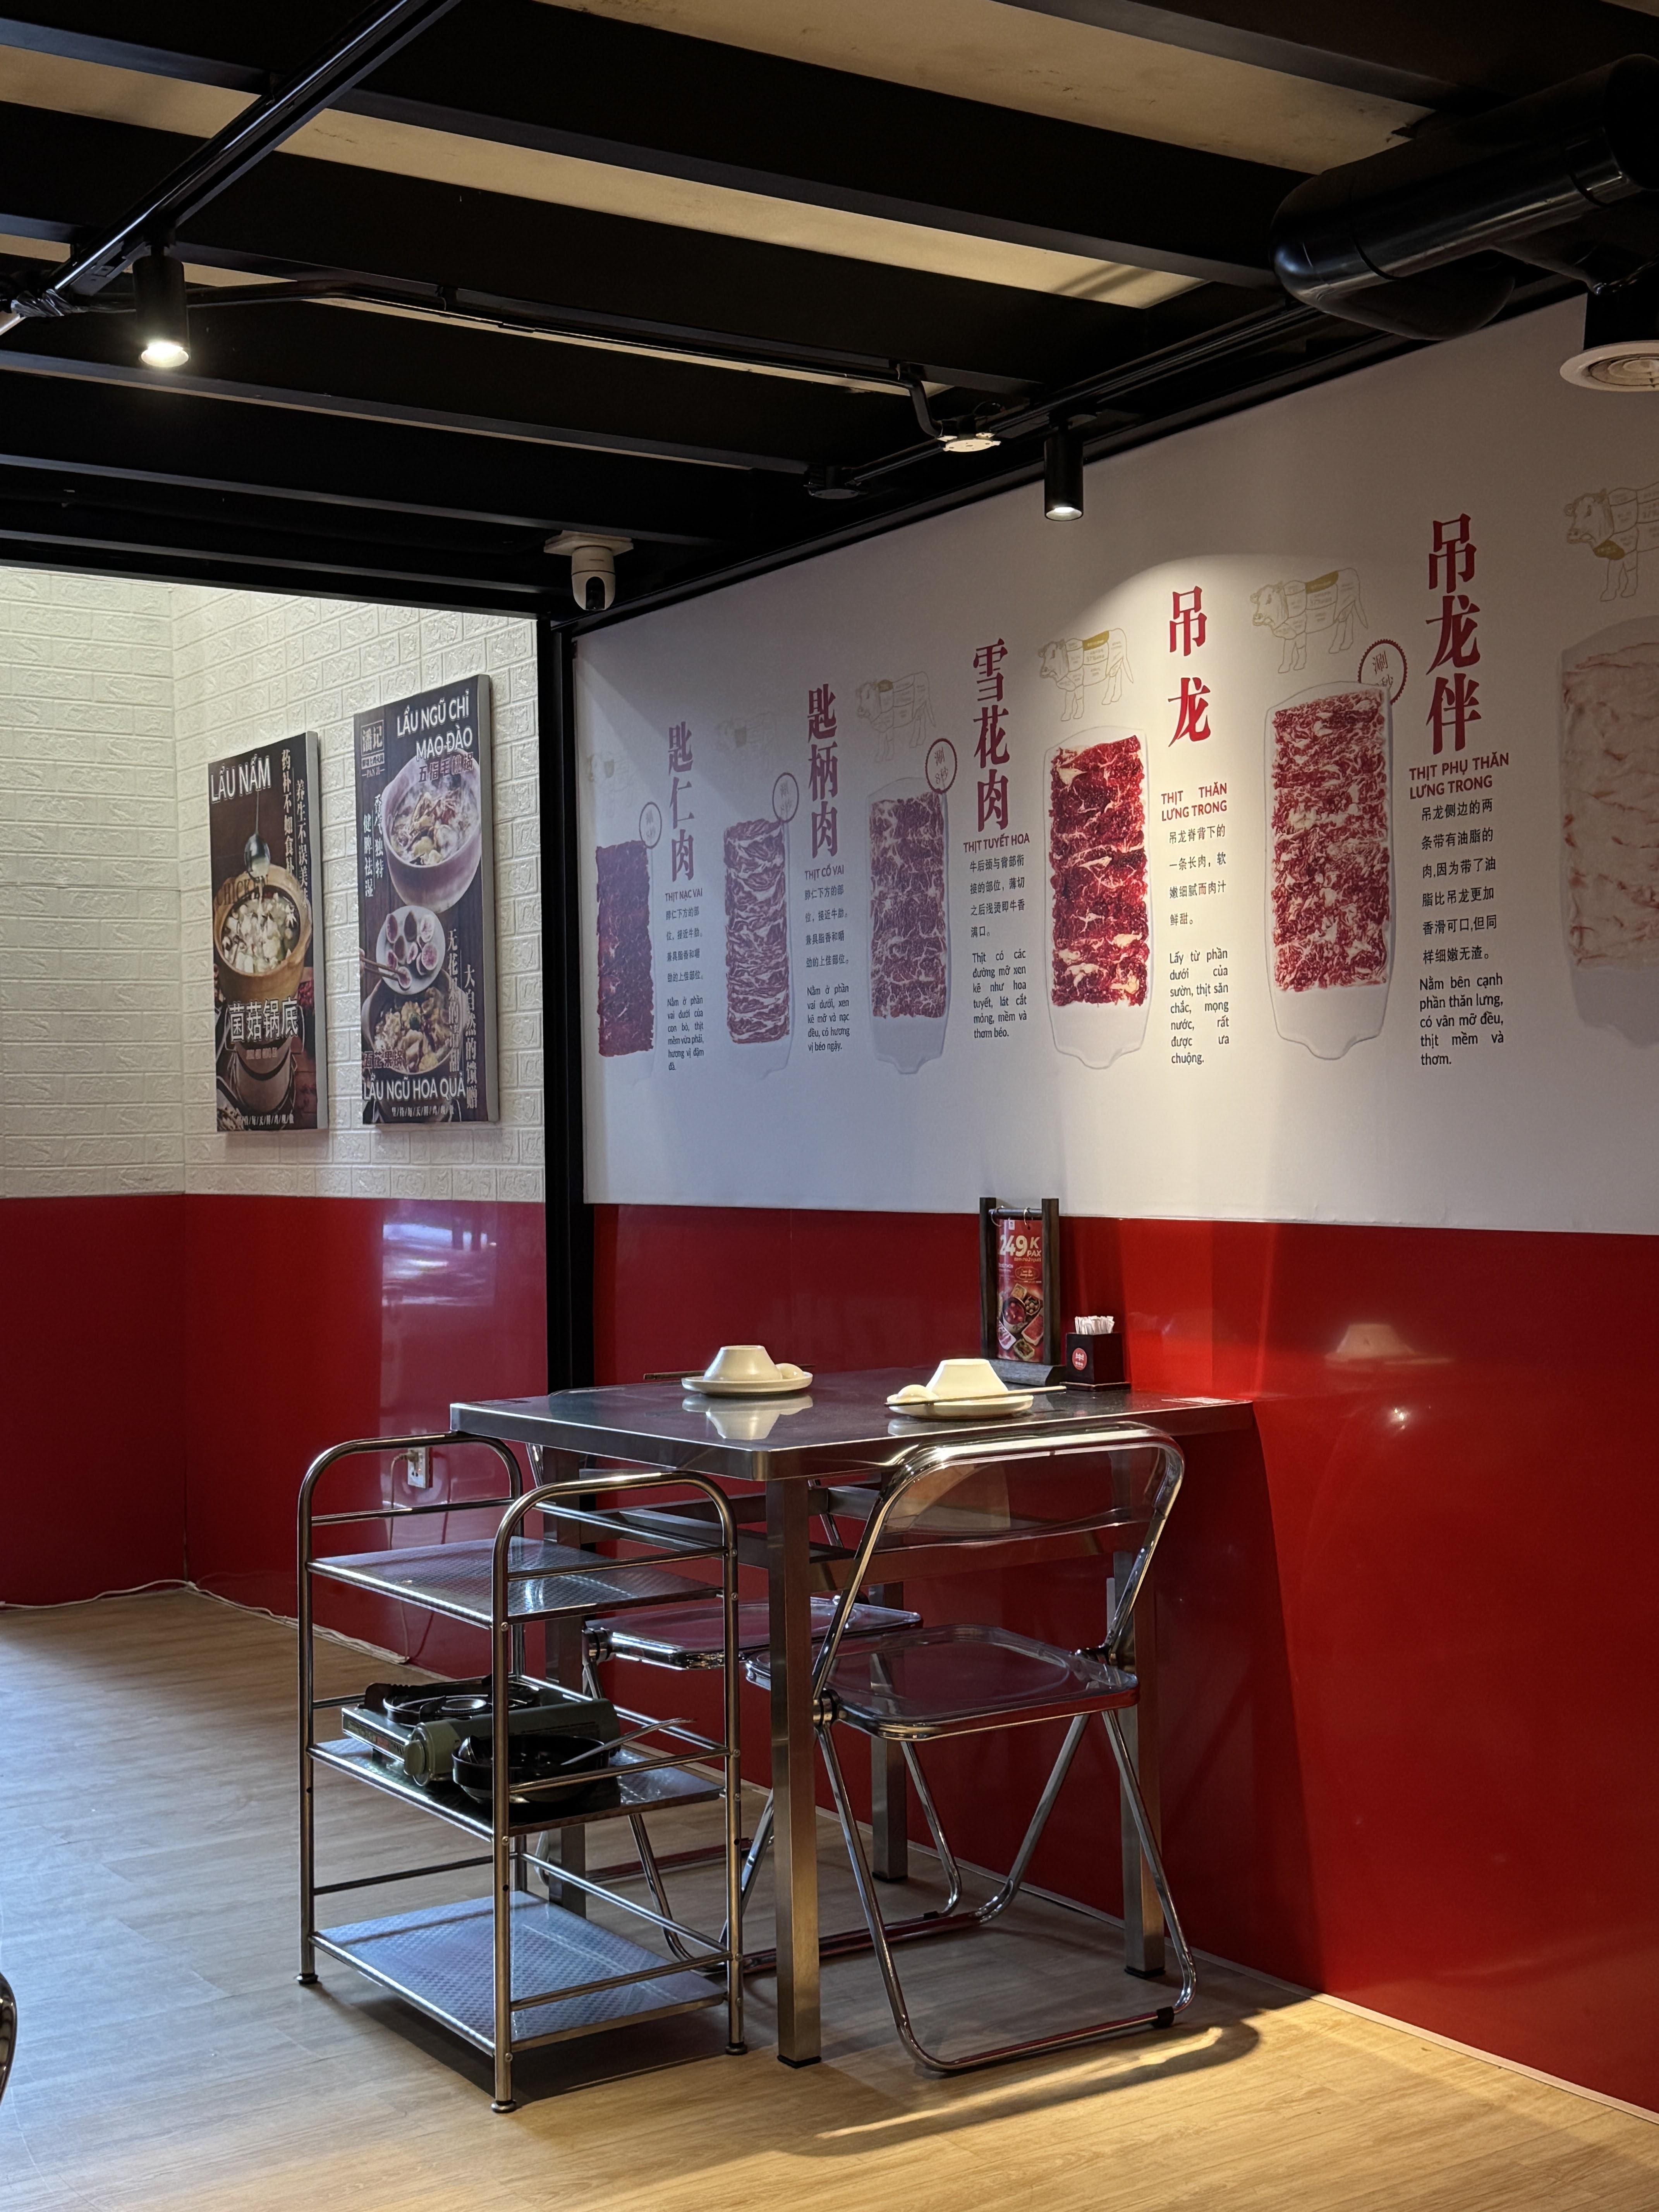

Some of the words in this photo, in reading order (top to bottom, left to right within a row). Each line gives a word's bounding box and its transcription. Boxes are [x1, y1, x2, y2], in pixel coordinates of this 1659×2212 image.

[1426, 513, 1481, 755] 吊龙伴
[1168, 586, 1211, 747] 吊龙
[397, 705, 418, 737] LẨU
[421, 698, 446, 730] NGŨ
[449, 689, 469, 721] CHỈ
[416, 737, 443, 761] MAO
[446, 724, 472, 756] ĐÀO
[973, 638, 1010, 832] 雪花肉
[807, 684, 838, 859] 匙柄肉
[1409, 764, 1437, 781] THỊT
[1442, 760, 1468, 775] PHỤ
[1473, 752, 1508, 770] THĂN
[211, 763, 234, 803] LẨU
[239, 754, 271, 796] NẤM
[1410, 783, 1444, 799] LƯNG
[1448, 775, 1492, 794] TRONG
[668, 721, 695, 882] 匙仁肉
[1161, 791, 1183, 805] THỊT
[1199, 782, 1227, 798] THĂN
[1162, 807, 1189, 821] LƯNG
[1192, 800, 1227, 816] TRONG
[1422, 799, 1492, 821] 吊龙侧边的两
[1169, 824, 1225, 844] 吊龙脊背下的
[1422, 828, 1493, 850] 条带有油脂的
[963, 840, 981, 853] THỊT
[983, 833, 1009, 849] TUYẾT
[1012, 833, 1030, 846] HOA
[805, 869, 820, 880] THỊT
[833, 865, 844, 875] VAI
[665, 892, 678, 902] THỊT
[680, 890, 691, 901] NẠC
[694, 888, 702, 897] VAI
[1170, 880, 1226, 899] 嫩细腻而肉汁
[1422, 886, 1494, 907] 脂比吊龙更加
[1170, 912, 1193, 926] 鲜甜。
[972, 952, 986, 964] Thịt
[996, 950, 1003, 960] có
[1014, 949, 1025, 959] các
[1170, 951, 1183, 965] Lấy
[1190, 950, 1200, 962] từ
[1207, 947, 1227, 962] phần
[1423, 945, 1489, 964] 样细嫩无渣。
[973, 967, 995, 978] đường
[999, 965, 1010, 976] mỡ
[1013, 966, 1026, 974] xen
[1170, 968, 1189, 980] dưới
[1213, 965, 1228, 976] của
[807, 986, 820, 996] Nằm
[835, 983, 848, 994] phần
[973, 983, 981, 993] kẽ
[990, 981, 1004, 991] như
[1013, 980, 1026, 990] hoa
[1170, 986, 1193, 997] sườn,
[1197, 983, 1211, 996] thịt
[1214, 983, 1228, 993] săn
[1420, 976, 1444, 991] Nằm
[1451, 976, 1470, 988] bên
[1477, 972, 1502, 988] cạnh
[667, 997, 678, 1006] Nằm
[690, 995, 702, 1006] phần
[820, 999, 835, 1009] dưới,
[974, 997, 993, 1010] tuyết,
[1000, 996, 1009, 1006] lát
[1016, 993, 1027, 1005] cắt
[1171, 1000, 1191, 1014] chắc,
[1205, 1001, 1229, 1013] mọng
[1420, 995, 1445, 1012] phần
[1449, 994, 1472, 1007] thăn
[1477, 993, 1503, 1007] lưng,
[229, 996, 298, 1042] 菌菇锅底
[694, 1008, 703, 1017] của
[817, 1013, 827, 1022] mỡ
[830, 1013, 836, 1022] và
[840, 1014, 849, 1023] nạc
[998, 1011, 1015, 1022] mềm
[1019, 1010, 1027, 1020] và
[1420, 1015, 1432, 1028] có
[1436, 1015, 1455, 1027] vân
[1459, 1013, 1477, 1026] mỡ
[1480, 1011, 1503, 1025] đều,
[695, 1022, 703, 1031] thịt
[1171, 1019, 1194, 1030] nước,
[1217, 1015, 1229, 1027] rất
[822, 1028, 828, 1036] có
[831, 1027, 850, 1037] hương
[974, 1029, 992, 1038] thơm
[994, 1027, 1009, 1037] béo.
[1421, 1034, 1438, 1049] thịt
[1452, 1031, 1478, 1045] mềm
[1491, 1030, 1504, 1043] và
[808, 1042, 813, 1053] vị
[815, 1042, 825, 1051] béo
[827, 1041, 842, 1052] ngậy.
[1171, 1036, 1192, 1048] được
[1219, 1035, 1229, 1044] ưa
[687, 1048, 690, 1058] vị
[1171, 1052, 1204, 1065] chuộng.
[1421, 1053, 1451, 1065] thơm.
[364, 1073, 383, 1100] LẨU
[387, 1077, 409, 1101] NGŨ
[413, 1077, 437, 1099] HOA
[440, 1073, 465, 1101] QUẢ
[1030, 1237, 1040, 1249] K
